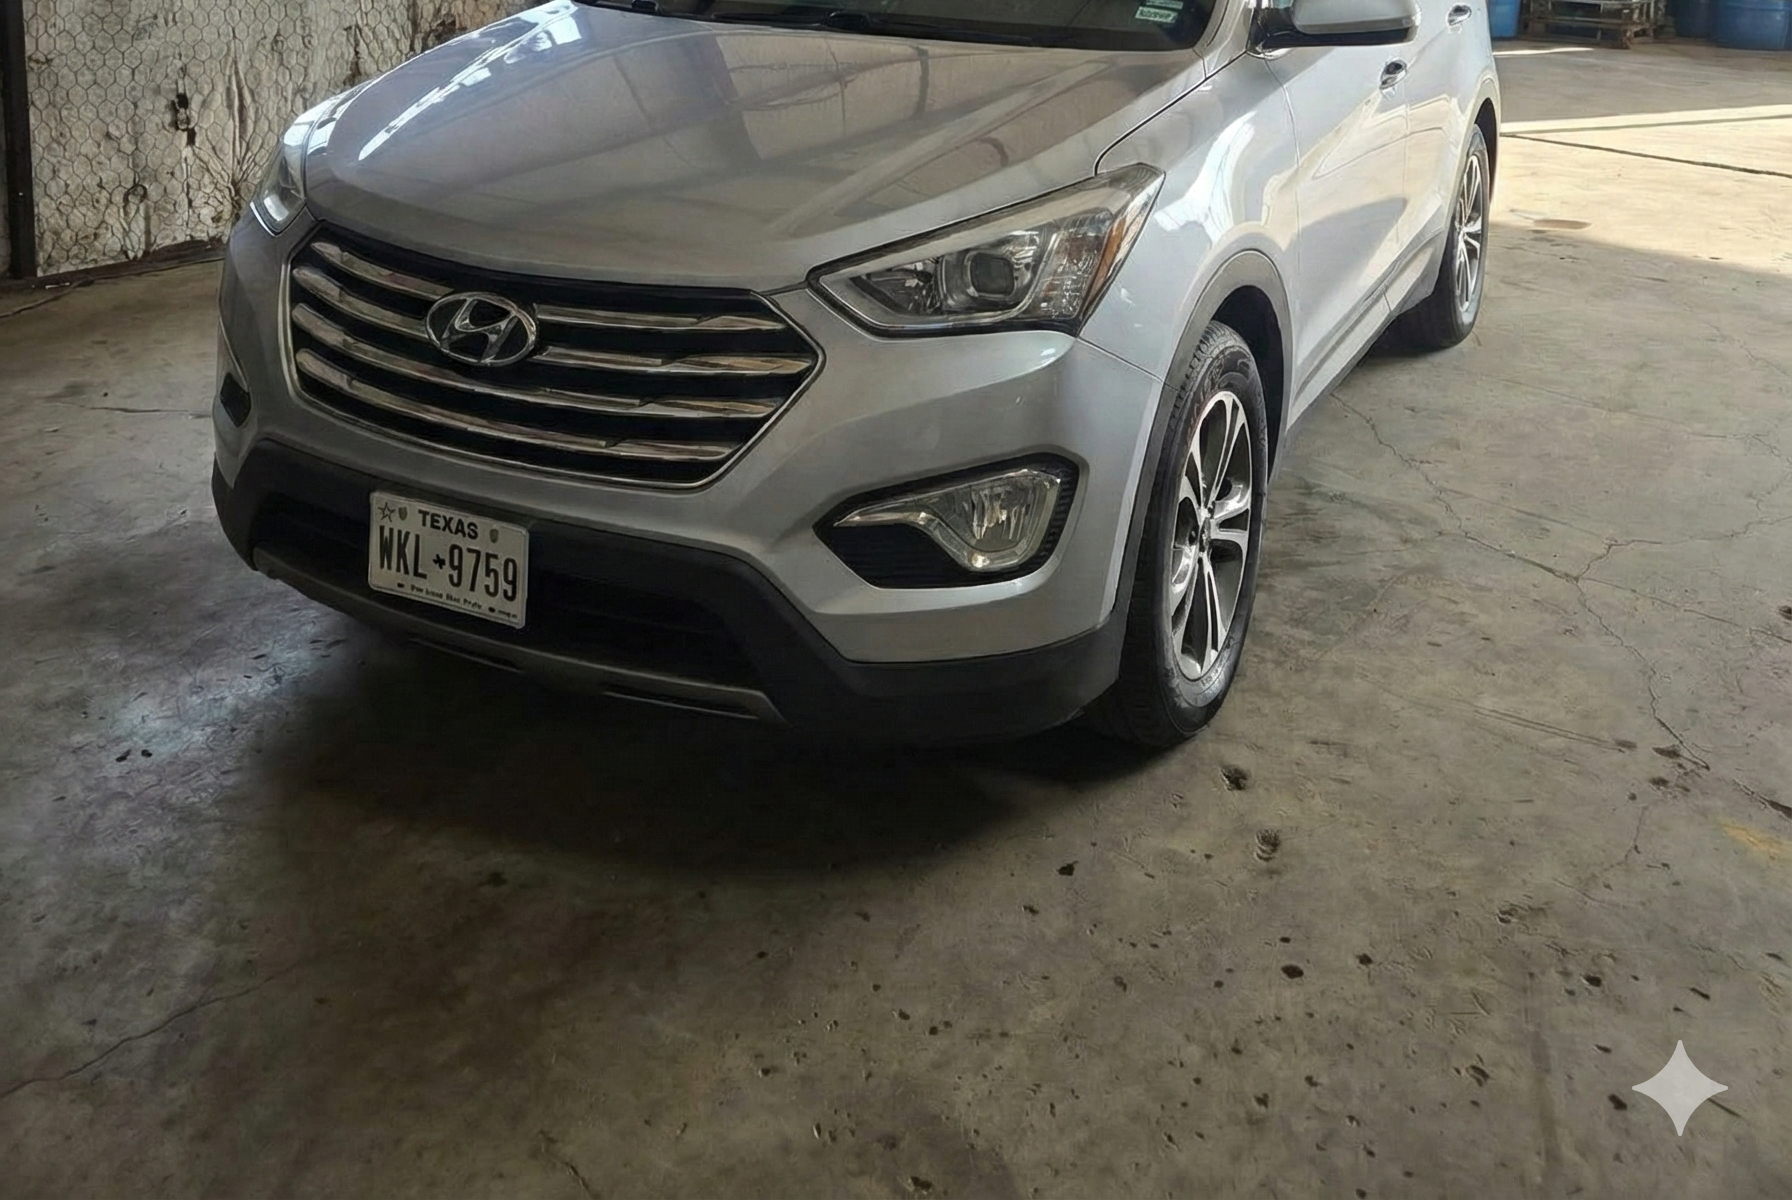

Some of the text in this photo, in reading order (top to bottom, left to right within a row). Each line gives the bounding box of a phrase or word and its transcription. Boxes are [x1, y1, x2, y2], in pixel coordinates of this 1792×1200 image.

[417, 508, 479, 541] TEXAS
[379, 525, 428, 580] WKL
[448, 543, 518, 602] 9759
